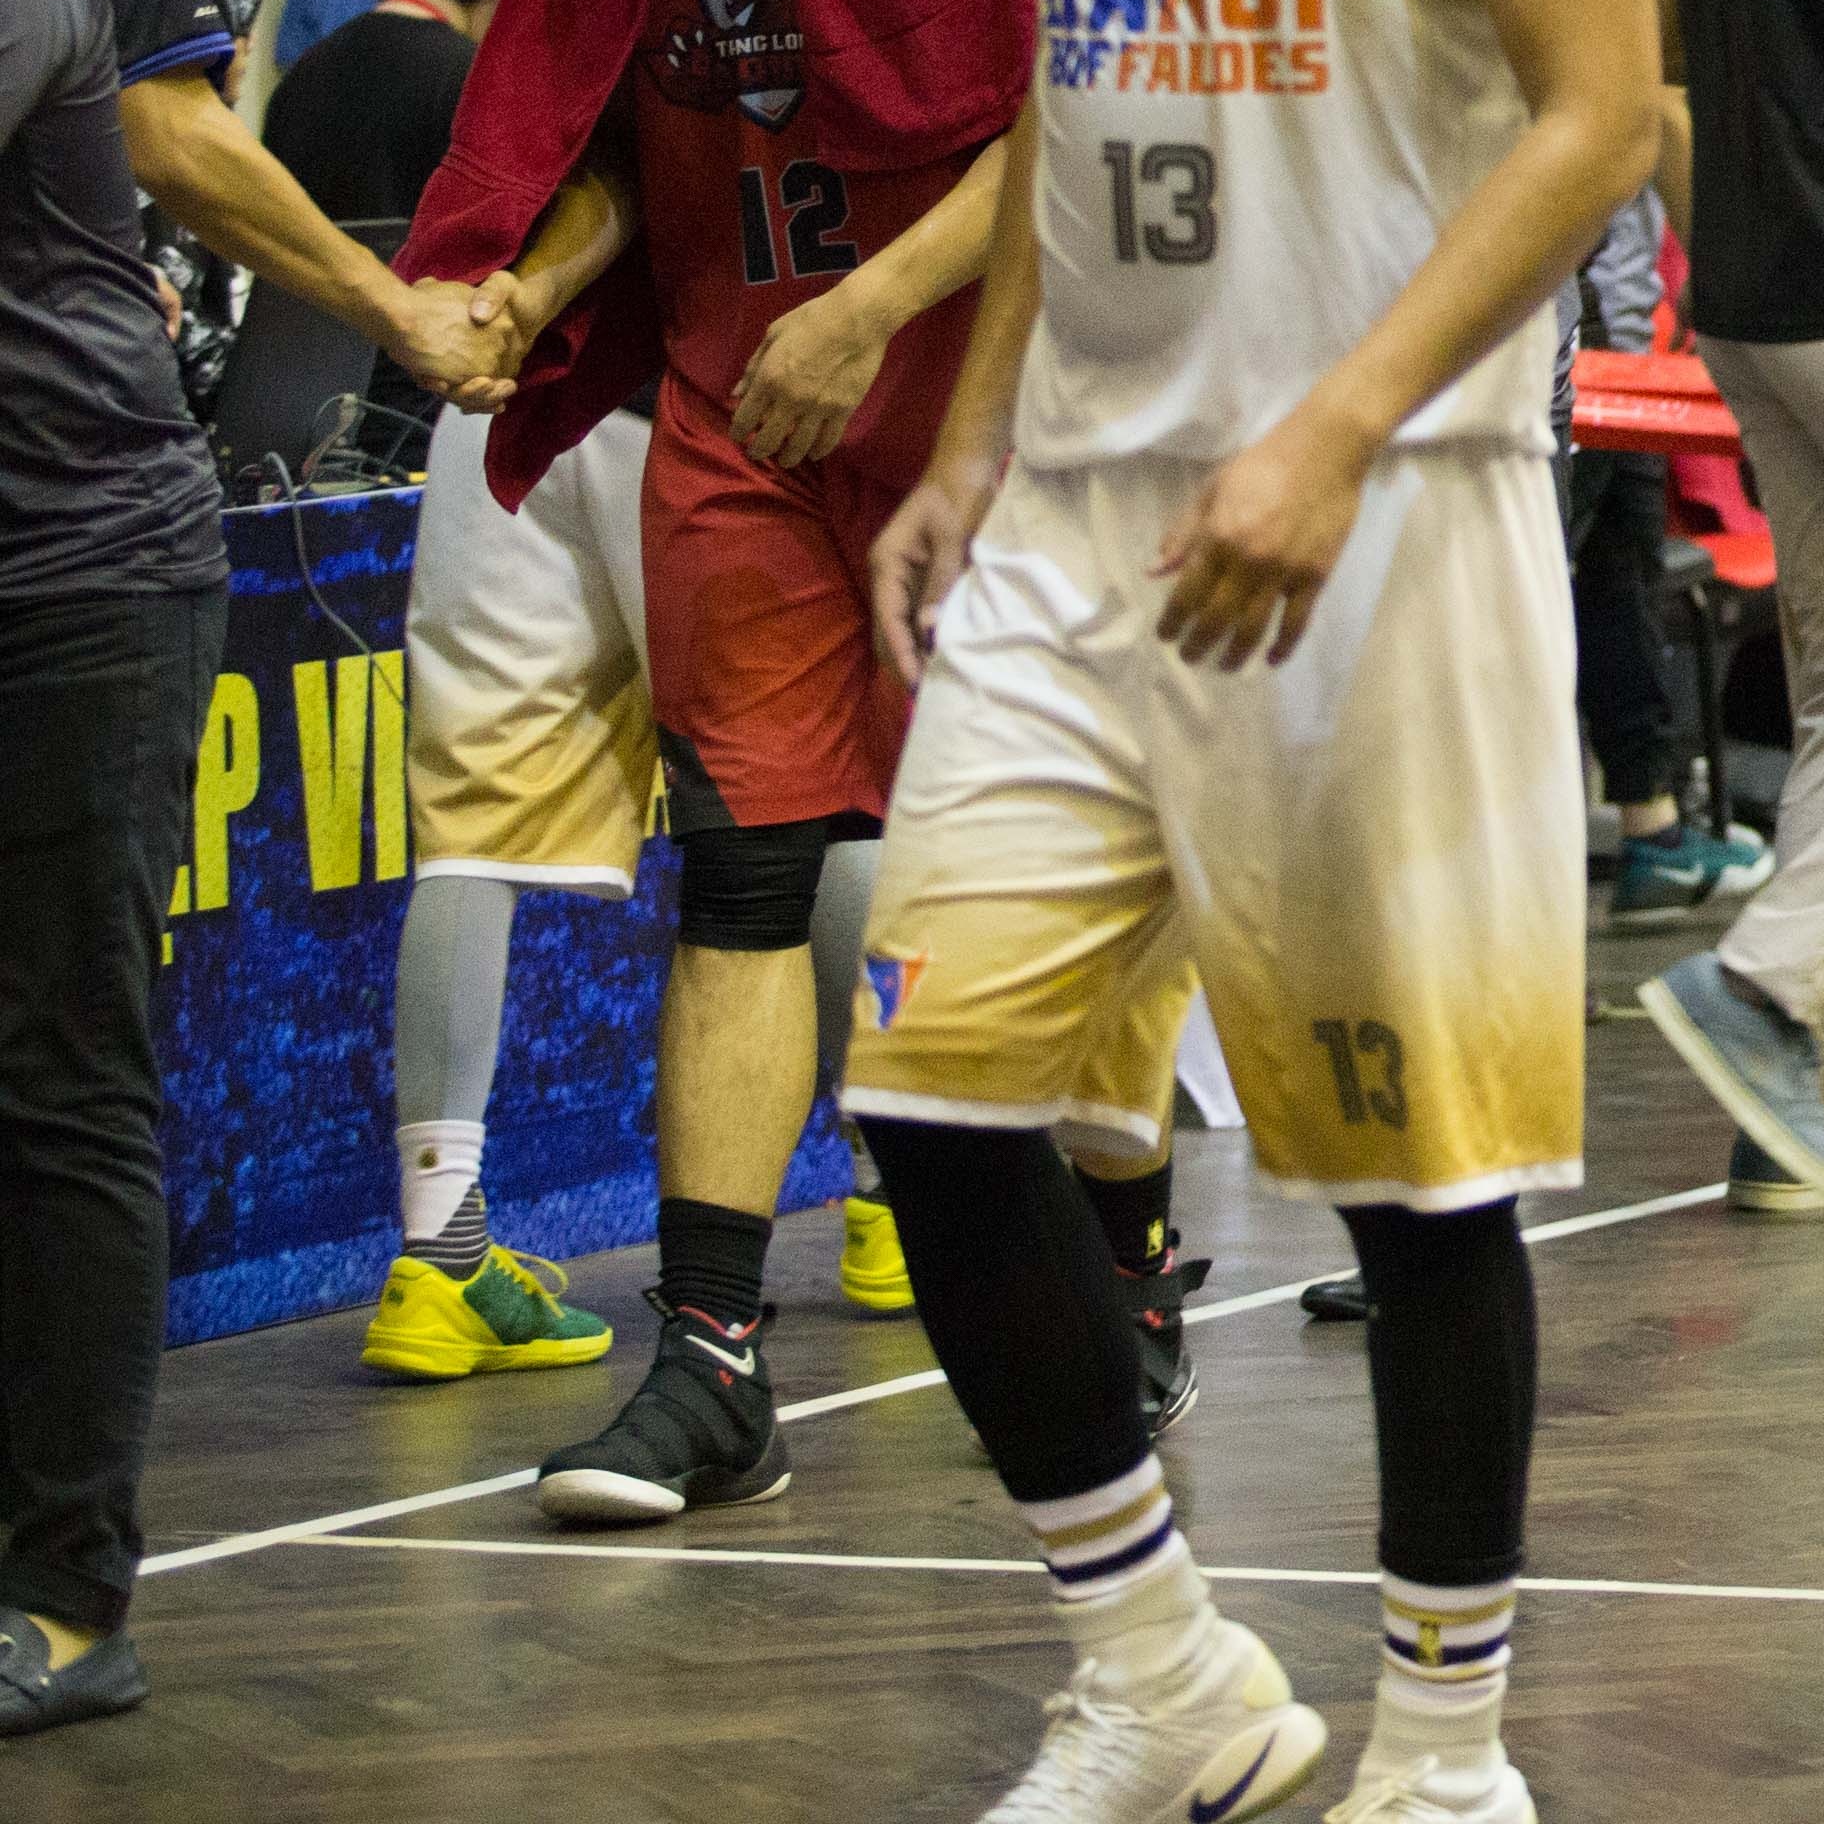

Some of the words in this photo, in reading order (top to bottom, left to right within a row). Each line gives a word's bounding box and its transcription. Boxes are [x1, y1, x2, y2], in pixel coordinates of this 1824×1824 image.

[740, 159, 860, 285] 12
[1102, 139, 1219, 265] 13
[1313, 1018, 1411, 1131] 13
